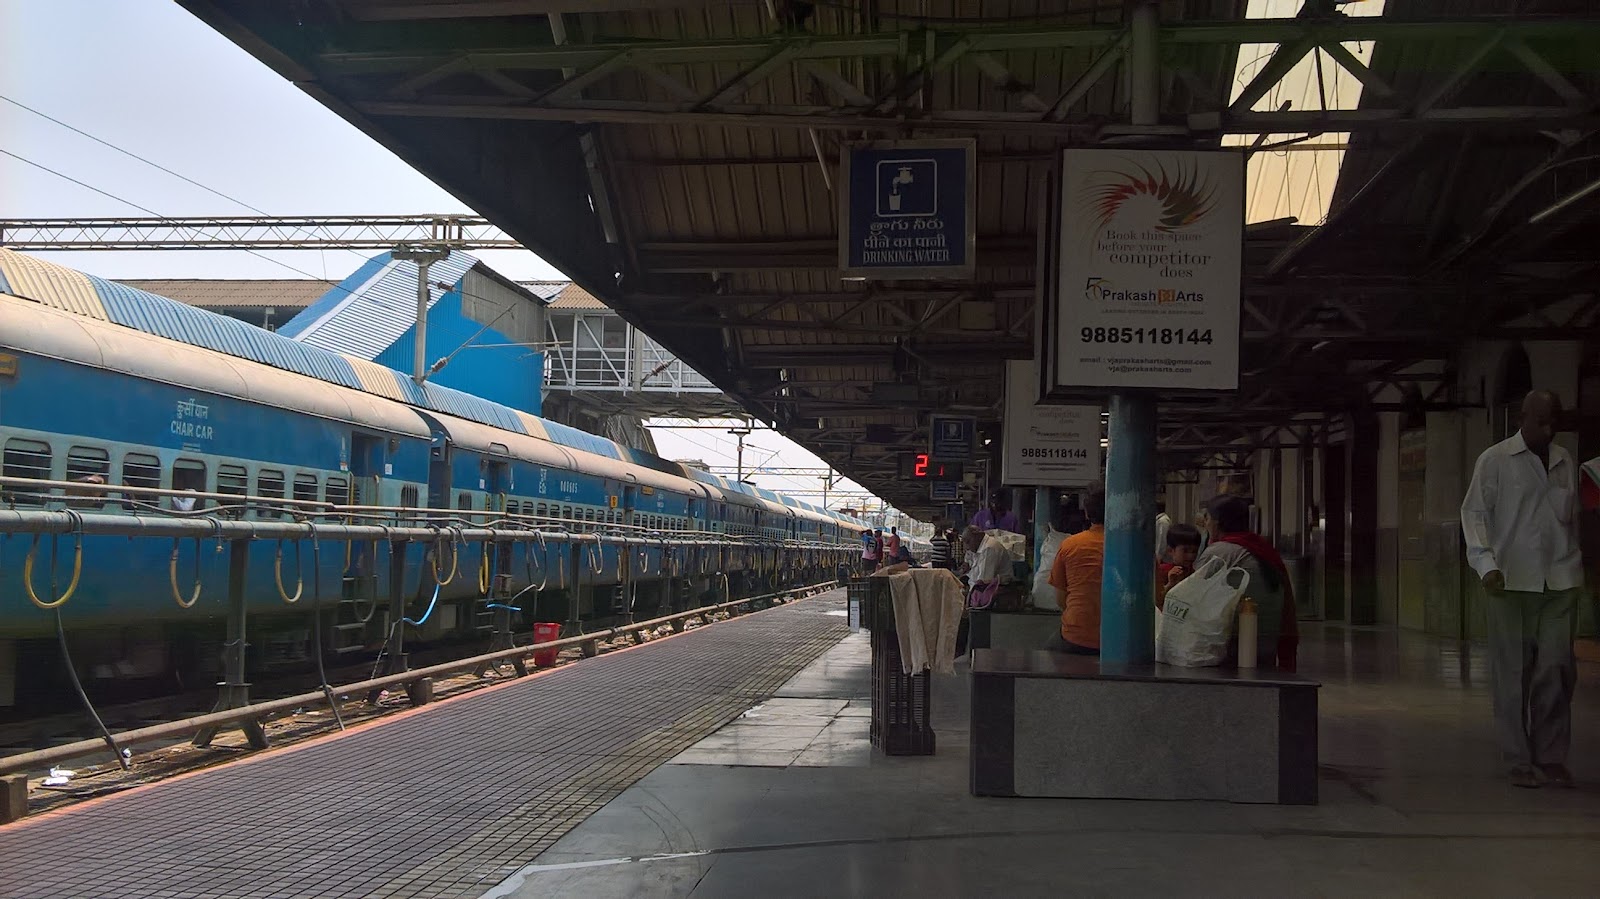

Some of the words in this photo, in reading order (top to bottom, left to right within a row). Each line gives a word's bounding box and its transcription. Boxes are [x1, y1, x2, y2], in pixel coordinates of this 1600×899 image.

[863, 234, 890, 249] पीने
[893, 237, 912, 248] का
[915, 233, 946, 248] पानी
[1106, 230, 1137, 240] Book
[1142, 231, 1165, 240] this
[1097, 240, 1136, 252] before
[1138, 244, 1168, 254] your
[863, 249, 912, 264] DRINKING
[914, 248, 951, 263] WATER
[1109, 250, 1212, 269] competitor
[1159, 265, 1194, 278] does
[1102, 289, 1157, 302] Prakash
[1175, 289, 1205, 303] Arts
[1080, 327, 1213, 345] 9885118144
[170, 420, 194, 438] CHAIR
[195, 424, 214, 440] CAR
[1021, 447, 1088, 459] 9885118144
